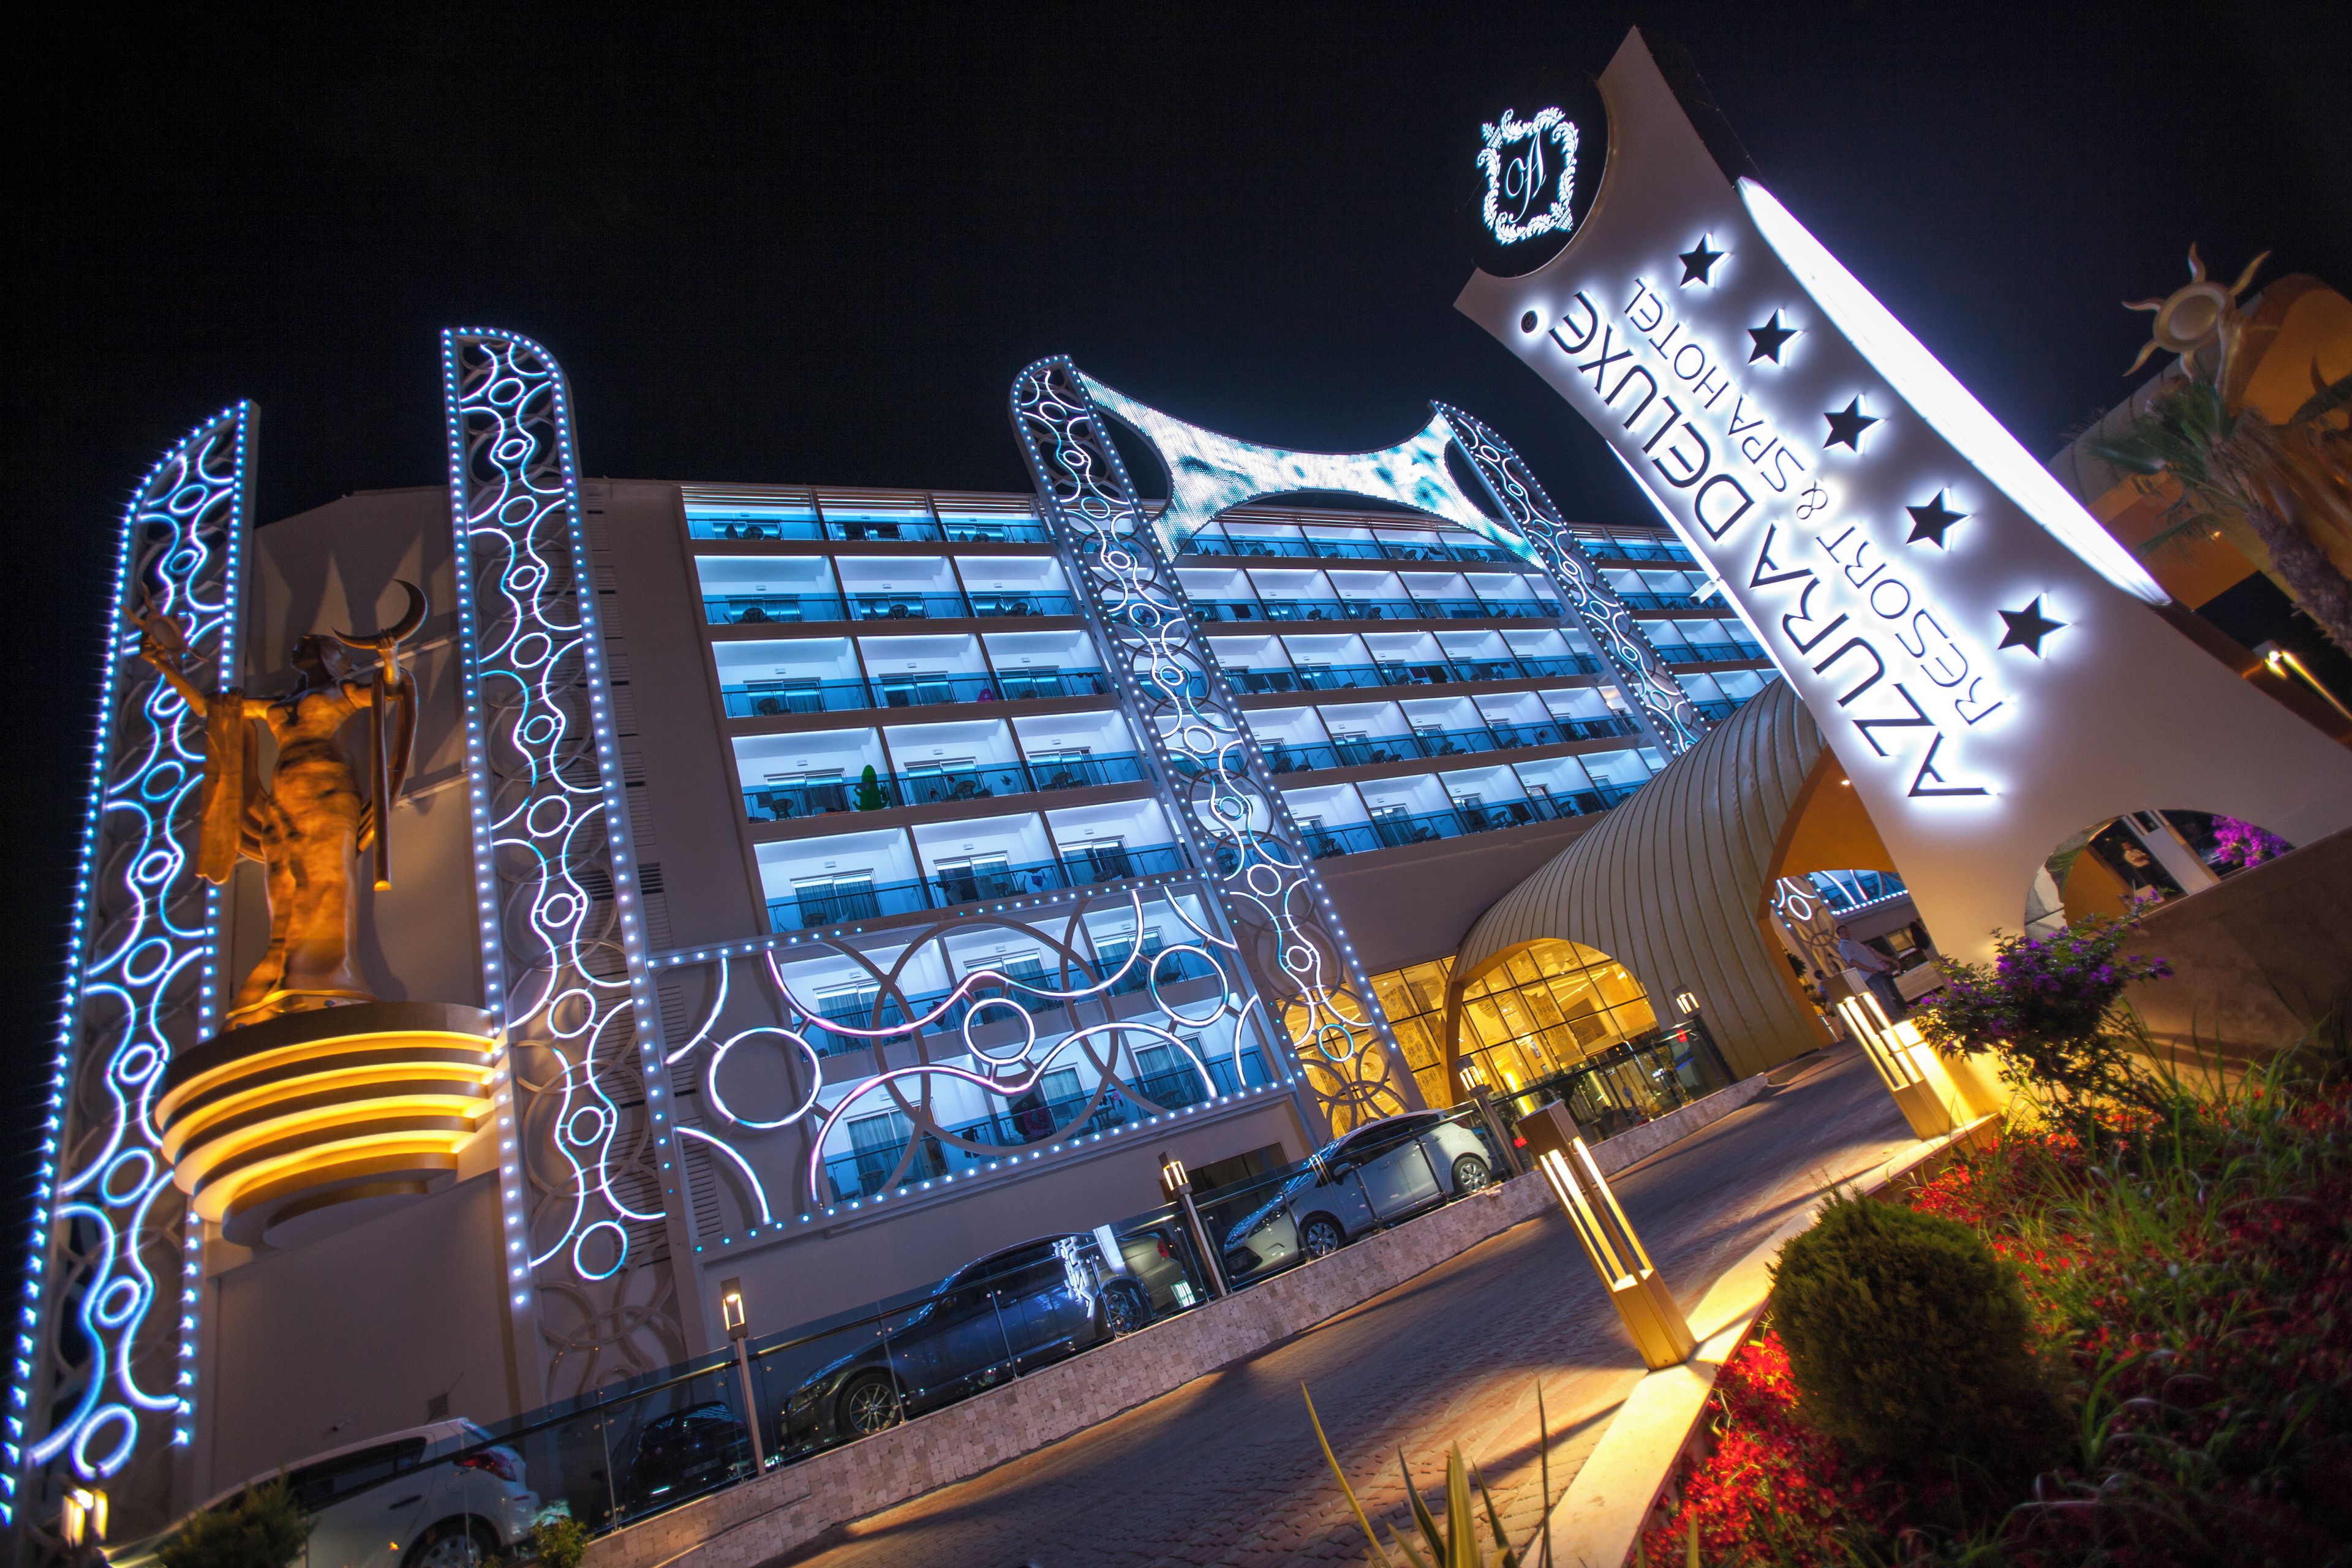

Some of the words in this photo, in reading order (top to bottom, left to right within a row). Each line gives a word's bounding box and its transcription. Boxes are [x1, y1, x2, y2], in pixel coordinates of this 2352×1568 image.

[1548, 291, 1755, 542] DELUXE
[1624, 277, 1732, 409] HOTEL
[1727, 396, 1806, 493] SPA
[1795, 479, 1829, 521] &
[1748, 522, 1997, 797] AZURA
[1815, 525, 2008, 725] RESORT
